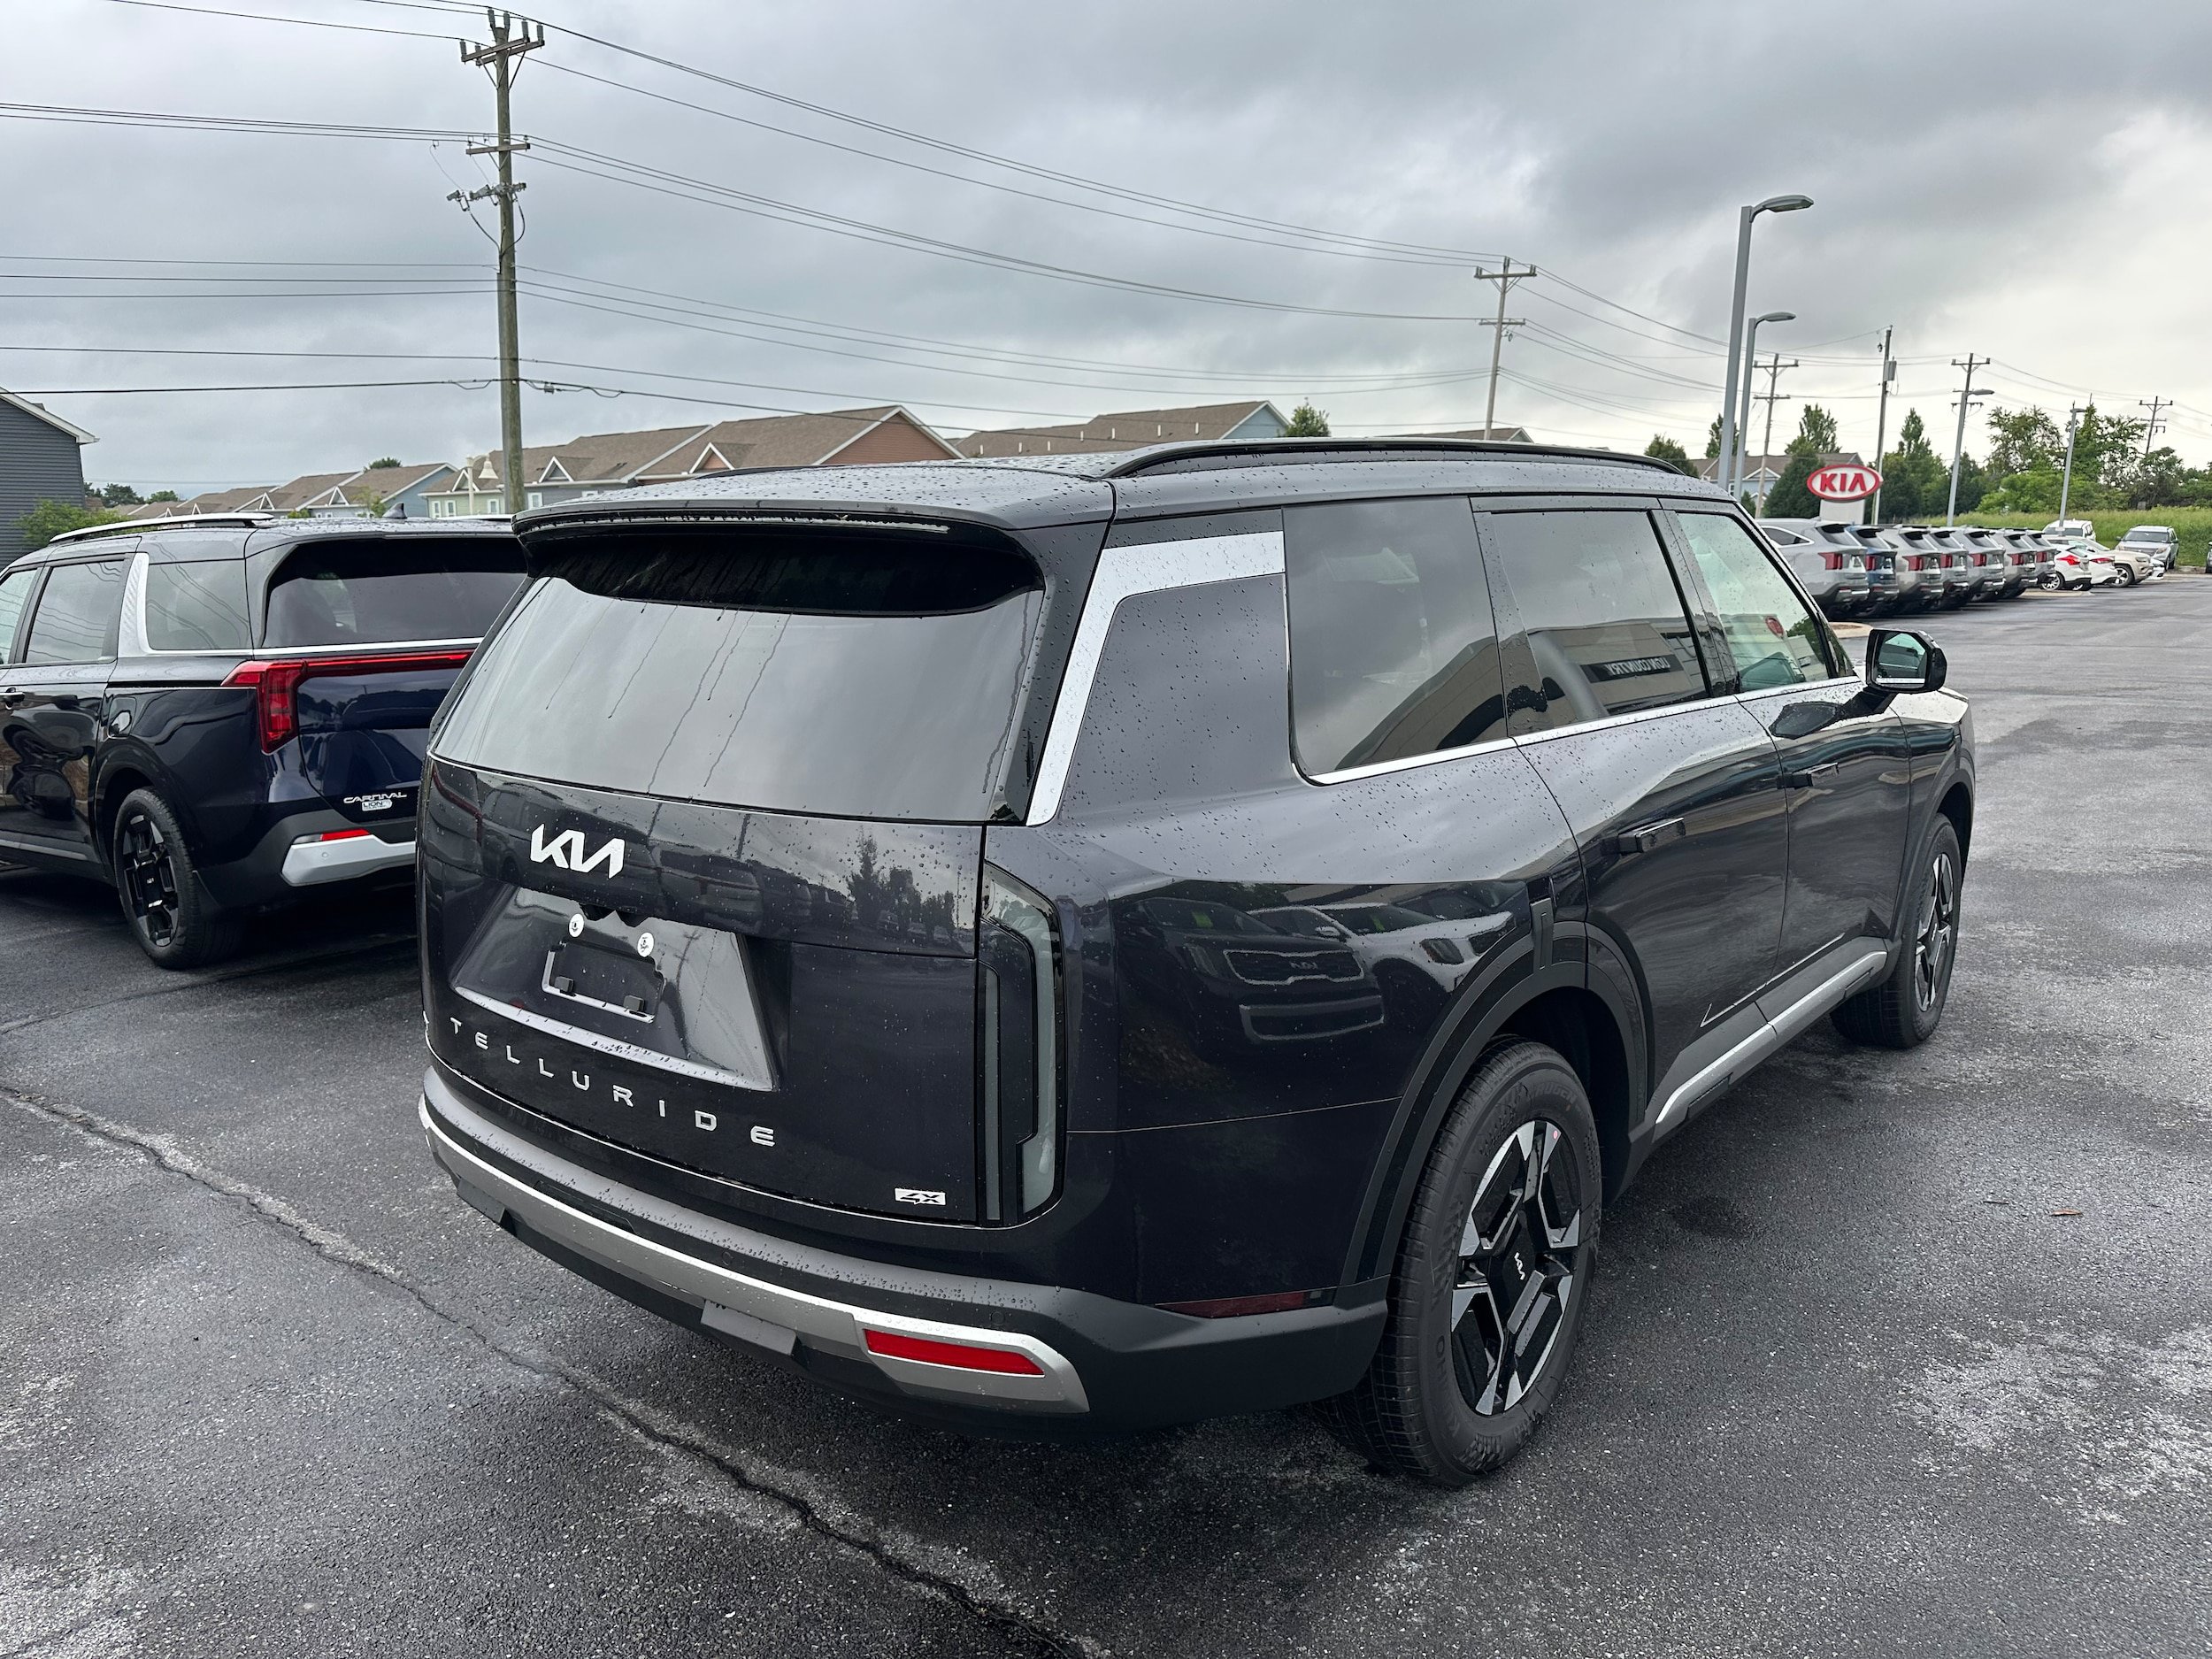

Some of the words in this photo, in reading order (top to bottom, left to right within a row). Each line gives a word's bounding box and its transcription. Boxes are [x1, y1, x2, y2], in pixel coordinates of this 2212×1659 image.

[1820, 472, 1867, 493] KIA
[343, 792, 408, 804] CARNIVAL
[530, 823, 626, 879] KIA
[449, 1017, 776, 1148] TELLURIDE
